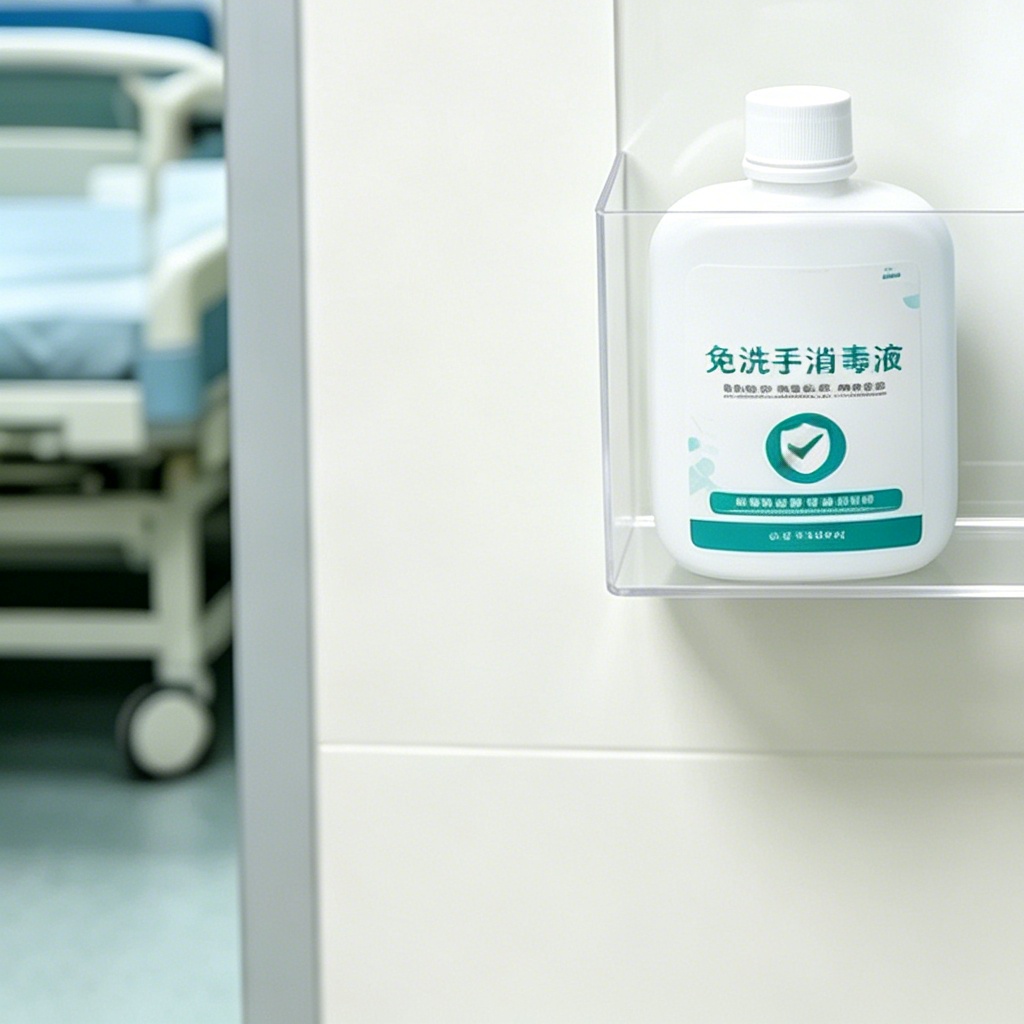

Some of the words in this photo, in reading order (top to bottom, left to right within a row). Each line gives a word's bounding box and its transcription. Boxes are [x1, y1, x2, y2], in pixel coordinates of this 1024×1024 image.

[705, 343, 903, 375] 免洗手消毒液
